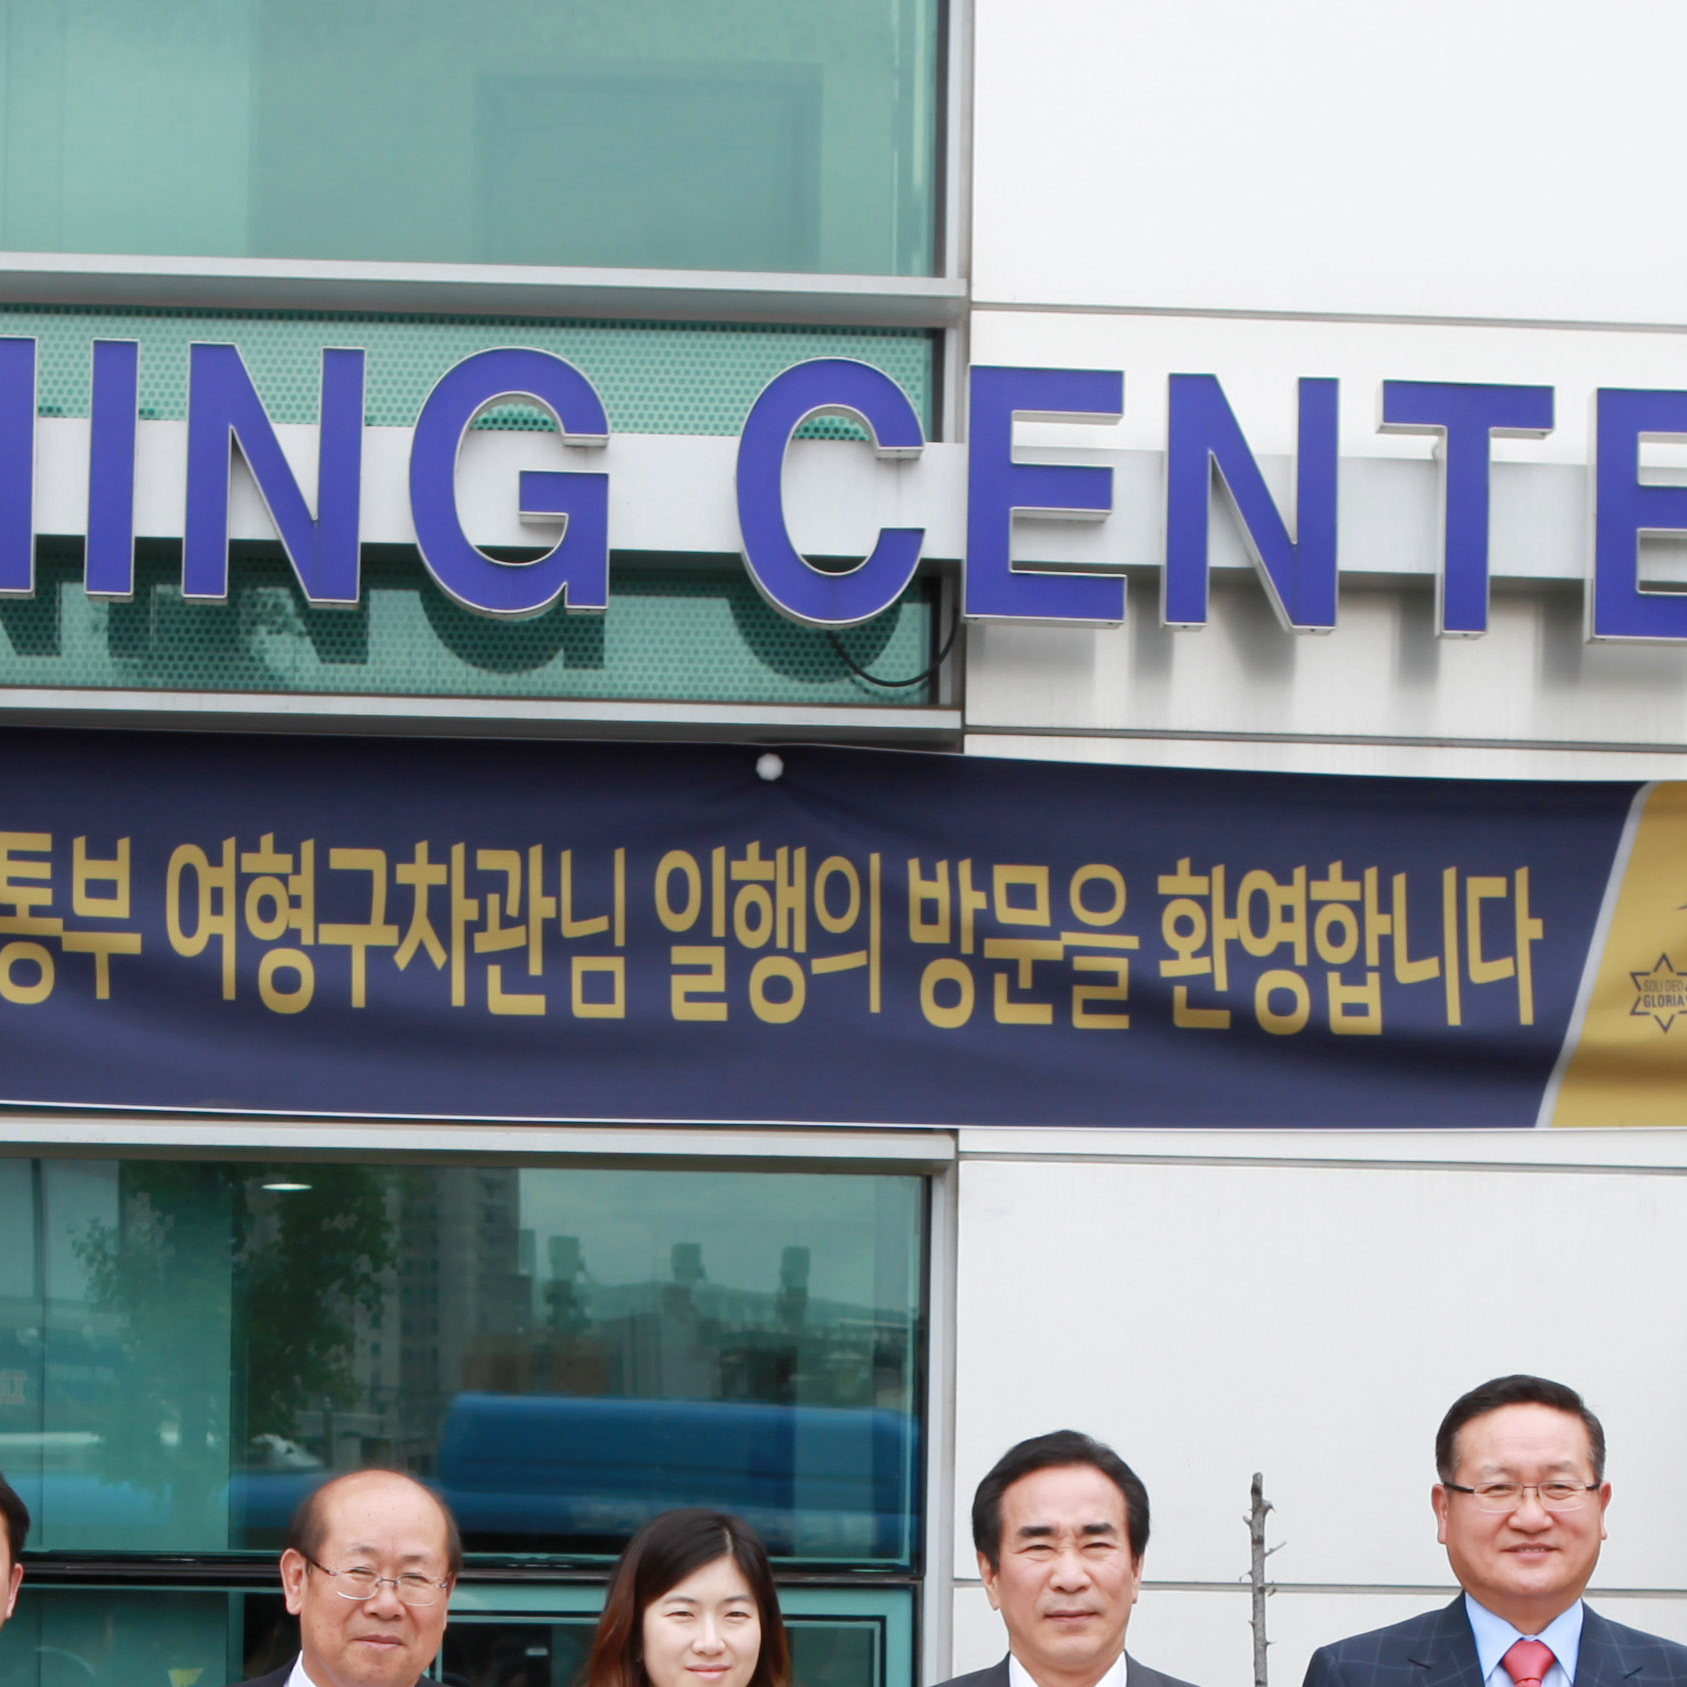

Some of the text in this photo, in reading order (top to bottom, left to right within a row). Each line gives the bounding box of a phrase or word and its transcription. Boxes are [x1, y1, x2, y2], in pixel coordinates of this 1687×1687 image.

[165, 831, 627, 1020] 여형구차관님
[655, 840, 883, 1025] 일행의
[908, 856, 1141, 1031] 방문을
[1157, 857, 1545, 1037] 환영합니다
[1644, 994, 1685, 1008] GLORIA
